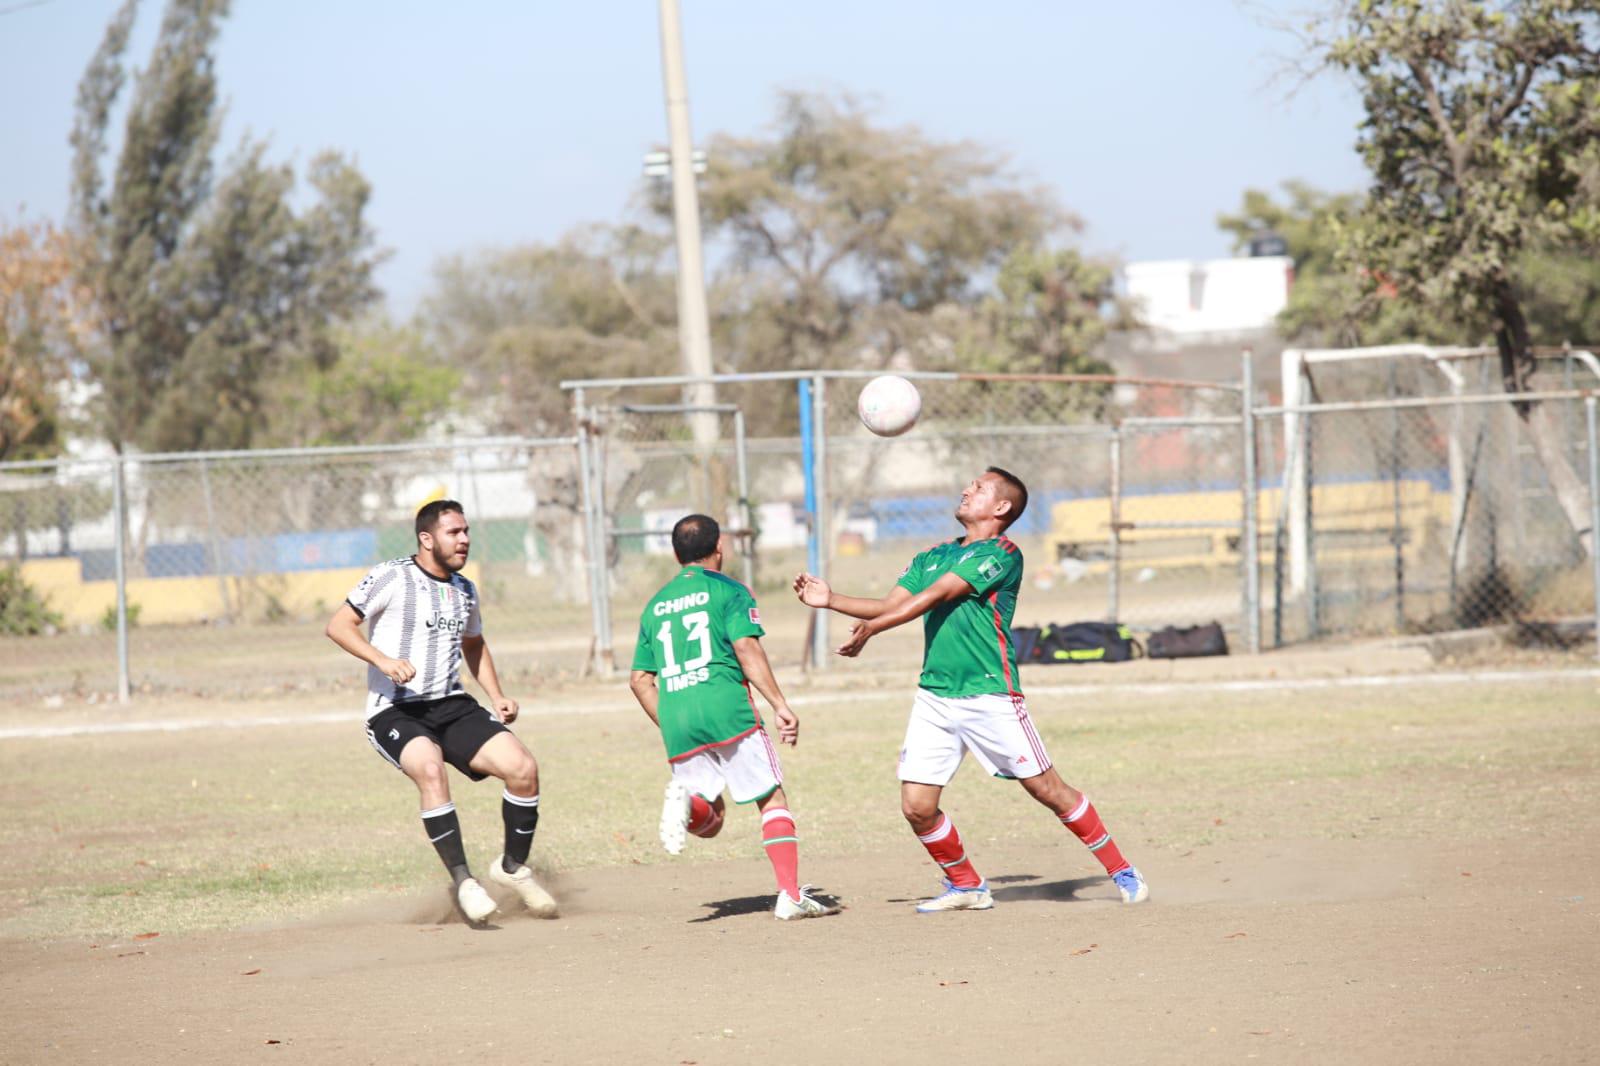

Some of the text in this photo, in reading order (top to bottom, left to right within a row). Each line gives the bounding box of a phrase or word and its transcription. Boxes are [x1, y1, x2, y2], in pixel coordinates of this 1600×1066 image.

[653, 592, 710, 616] CHINO
[425, 611, 465, 636] Jeep
[656, 610, 713, 679] 13
[666, 667, 710, 693] IMSS
